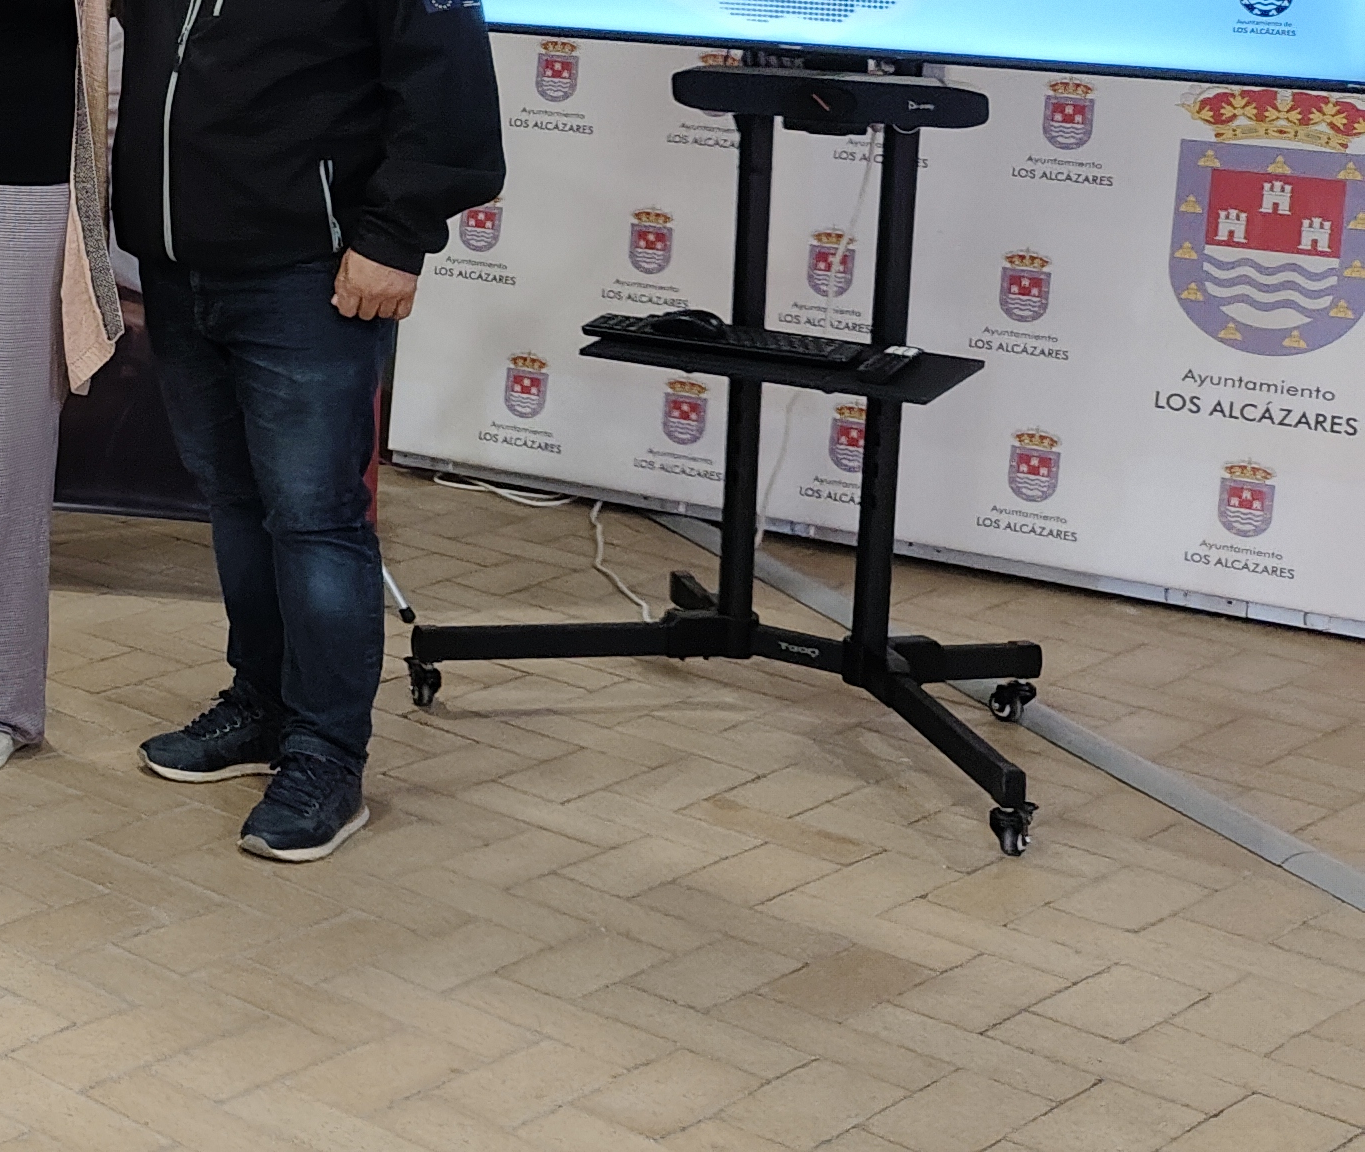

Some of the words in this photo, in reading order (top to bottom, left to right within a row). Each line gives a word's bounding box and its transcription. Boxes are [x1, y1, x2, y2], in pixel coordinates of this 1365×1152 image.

[508, 117, 529, 129] LOS
[532, 119, 594, 135] ALCÁZARES
[691, 134, 738, 149] ALCÁZA
[1011, 166, 1036, 179] LOS
[1039, 170, 1114, 187] ALCÁZARES
[434, 265, 454, 278] LOS
[456, 269, 517, 286] ALCÁZARES
[968, 337, 993, 350] LOS
[995, 342, 1069, 361] ALCÁZARES
[1181, 368, 1336, 402] Ayuntamiento
[1154, 390, 1201, 414] LOS
[1207, 399, 1359, 436] ALCÁZARES
[478, 430, 499, 443] LOS
[799, 485, 822, 499] LOS
[976, 516, 1001, 529] LOS
[1002, 521, 1078, 542] ALCÁZARES
[1199, 539, 1283, 561] Ayuntamiento
[1184, 550, 1211, 565] LOS
[1213, 557, 1295, 580] ALCÁZARES
